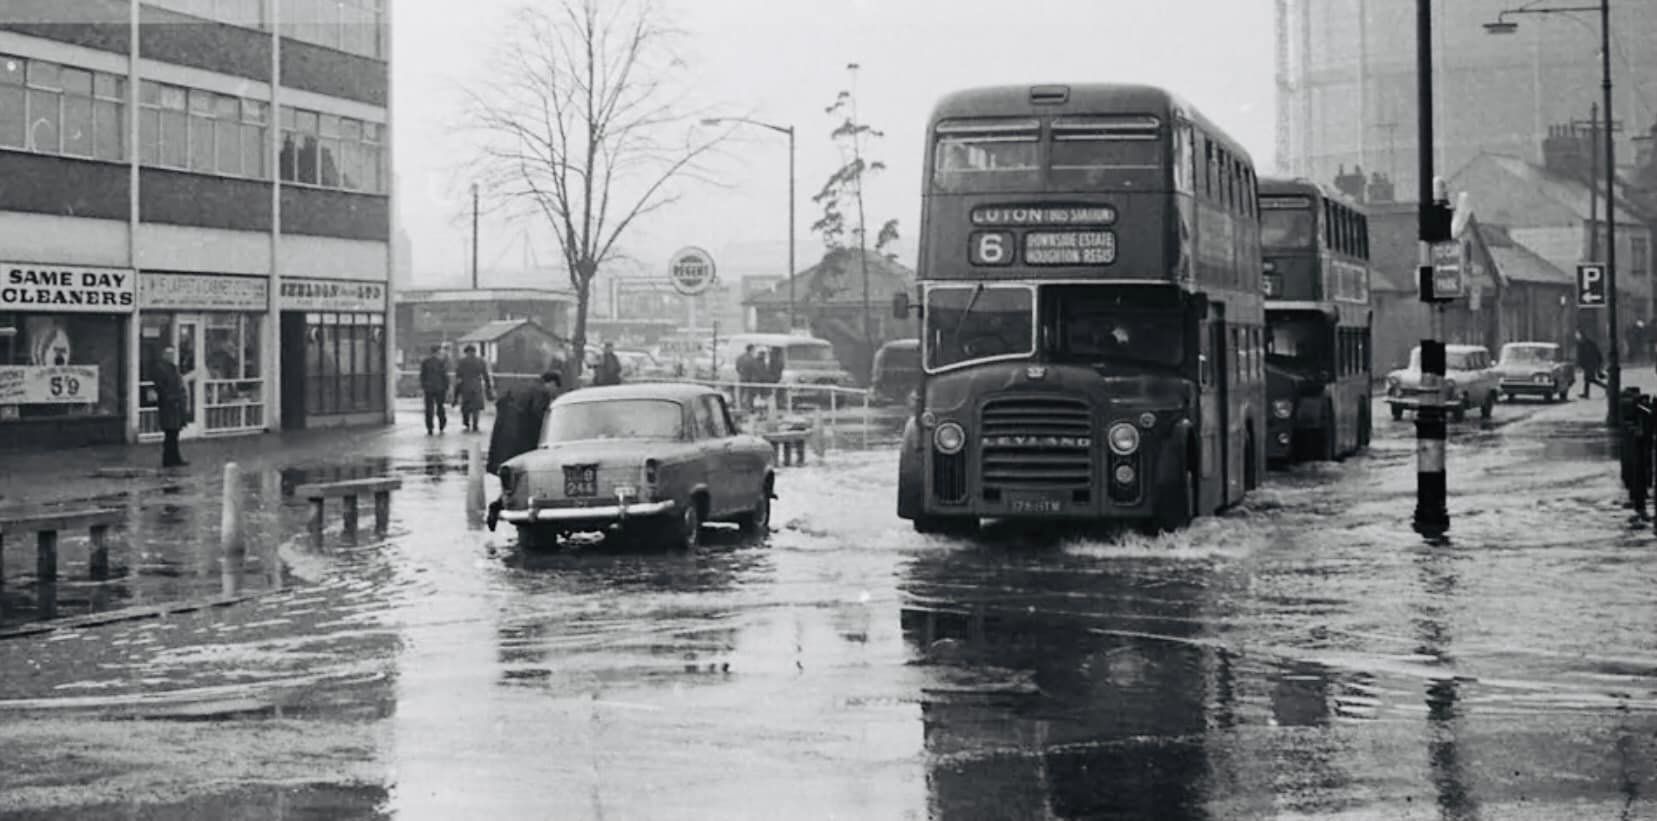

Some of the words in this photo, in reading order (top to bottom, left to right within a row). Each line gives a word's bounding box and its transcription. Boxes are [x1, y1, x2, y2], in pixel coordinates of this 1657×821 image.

[972, 208, 1042, 223] LUTON
[1079, 232, 1114, 247] ESTATE
[979, 233, 1003, 262] 6
[1083, 248, 1113, 263] REGIS
[9, 269, 73, 286] SAME
[82, 273, 125, 288] DAY
[673, 265, 709, 277] REGENT
[1582, 267, 1600, 290] P
[2, 288, 133, 305] CLEANERS
[981, 437, 1091, 448] LEYLAND
